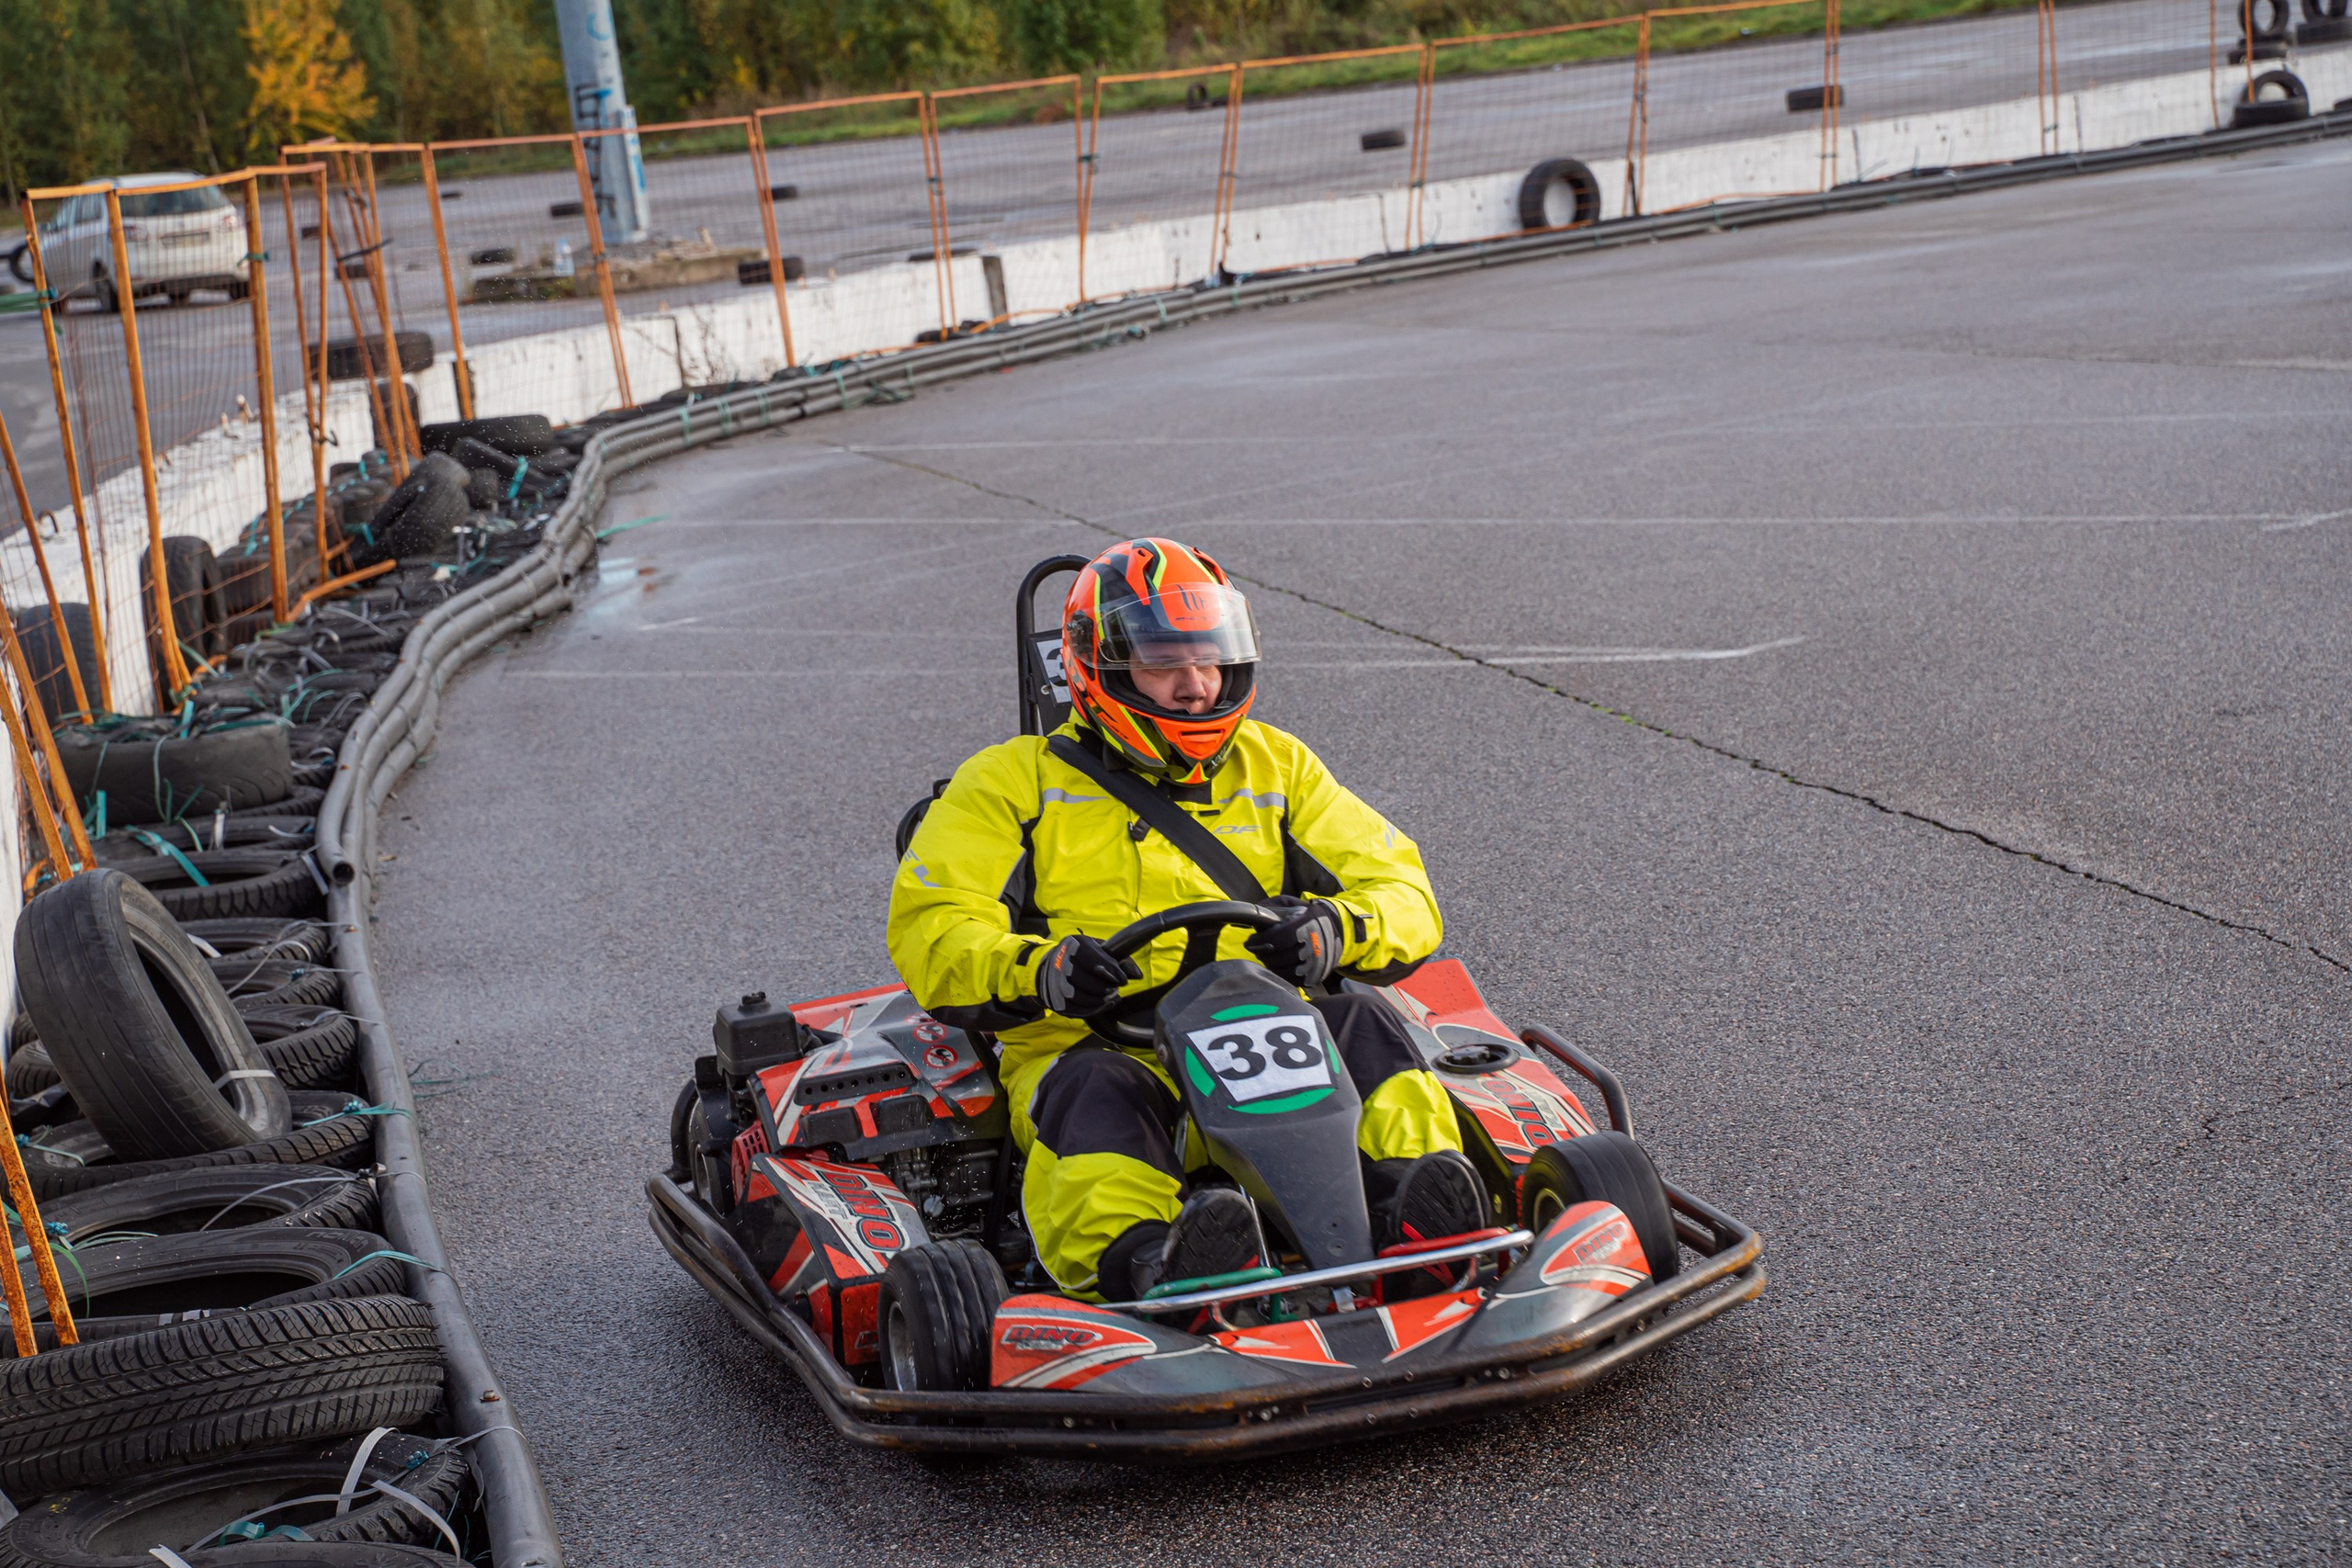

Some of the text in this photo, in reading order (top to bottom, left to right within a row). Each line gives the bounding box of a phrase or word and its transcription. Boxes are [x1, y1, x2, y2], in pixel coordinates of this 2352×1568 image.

[1208, 1025, 1322, 1081] 38
[1481, 1078, 1559, 1148] DINO
[808, 1180, 848, 1220] KART
[814, 1169, 906, 1252] DINO
[1576, 1224, 1624, 1261] DINO
[1002, 1325, 1097, 1346] DINO
